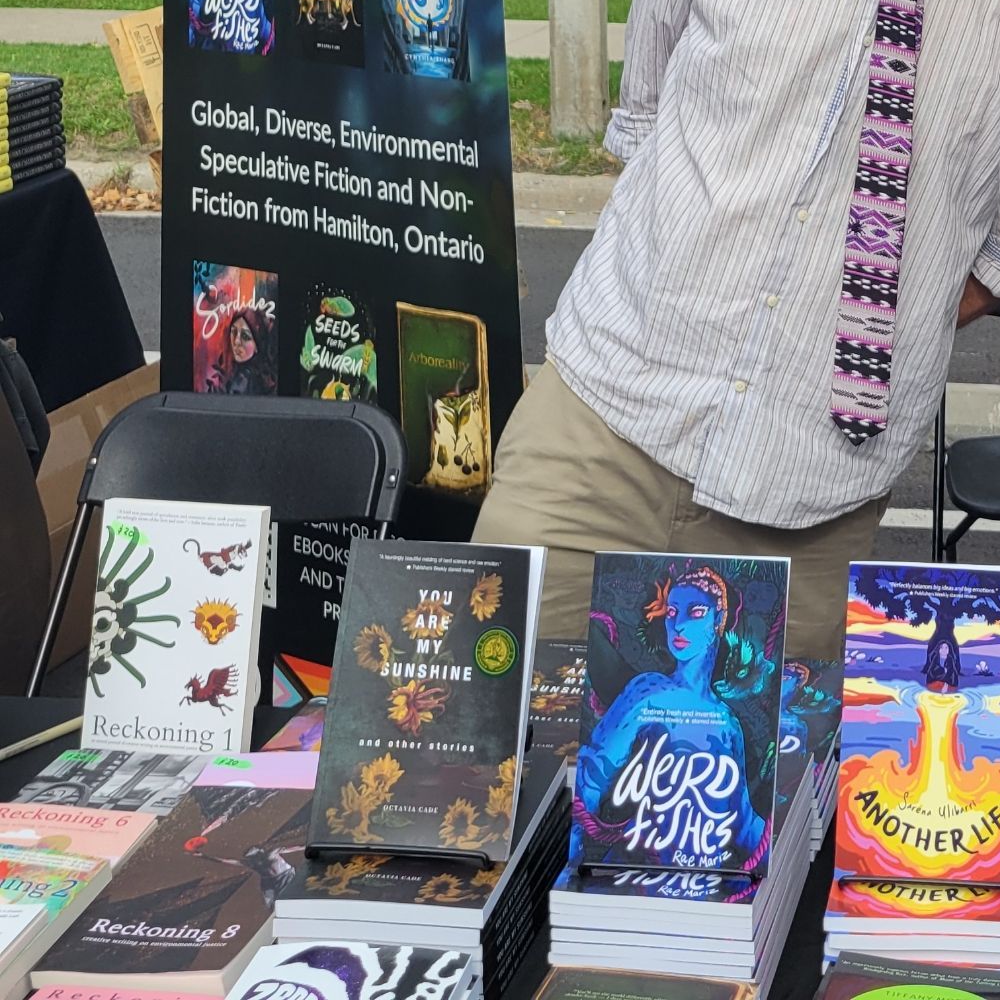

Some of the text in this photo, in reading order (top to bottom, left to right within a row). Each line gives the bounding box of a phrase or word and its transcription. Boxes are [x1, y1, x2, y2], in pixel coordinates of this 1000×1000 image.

[192, 100, 478, 168] Global, Diverse, Environmental
[200, 145, 474, 213] Speculative Fiction and Non-
[192, 187, 484, 264] Fiction from Hamilton, Ontario
[196, 284, 276, 340] Sordidez
[315, 314, 360, 343] SEEDS
[409, 351, 470, 372] Arboreality
[294, 534, 350, 566] EBOOKS
[300, 566, 332, 589] AND
[419, 589, 452, 605] YOU
[415, 614, 450, 630] ARE
[417, 640, 442, 655] MY
[380, 662, 473, 681] SUNSHINE
[92, 715, 233, 752] Reckoning 1
[359, 739, 475, 752] and other stories
[0, 807, 132, 828] Reckoning 6
[383, 804, 439, 814] OCTAVIA CADE
[854, 789, 978, 854] ANOTHER
[672, 850, 732, 868] Rae Mariz
[365, 873, 399, 881] OCTAVIA
[52, 879, 77, 898] 2
[657, 884, 719, 897] Rae Mariz
[81, 936, 111, 944] creative
[88, 918, 241, 942] Reckoning 8
